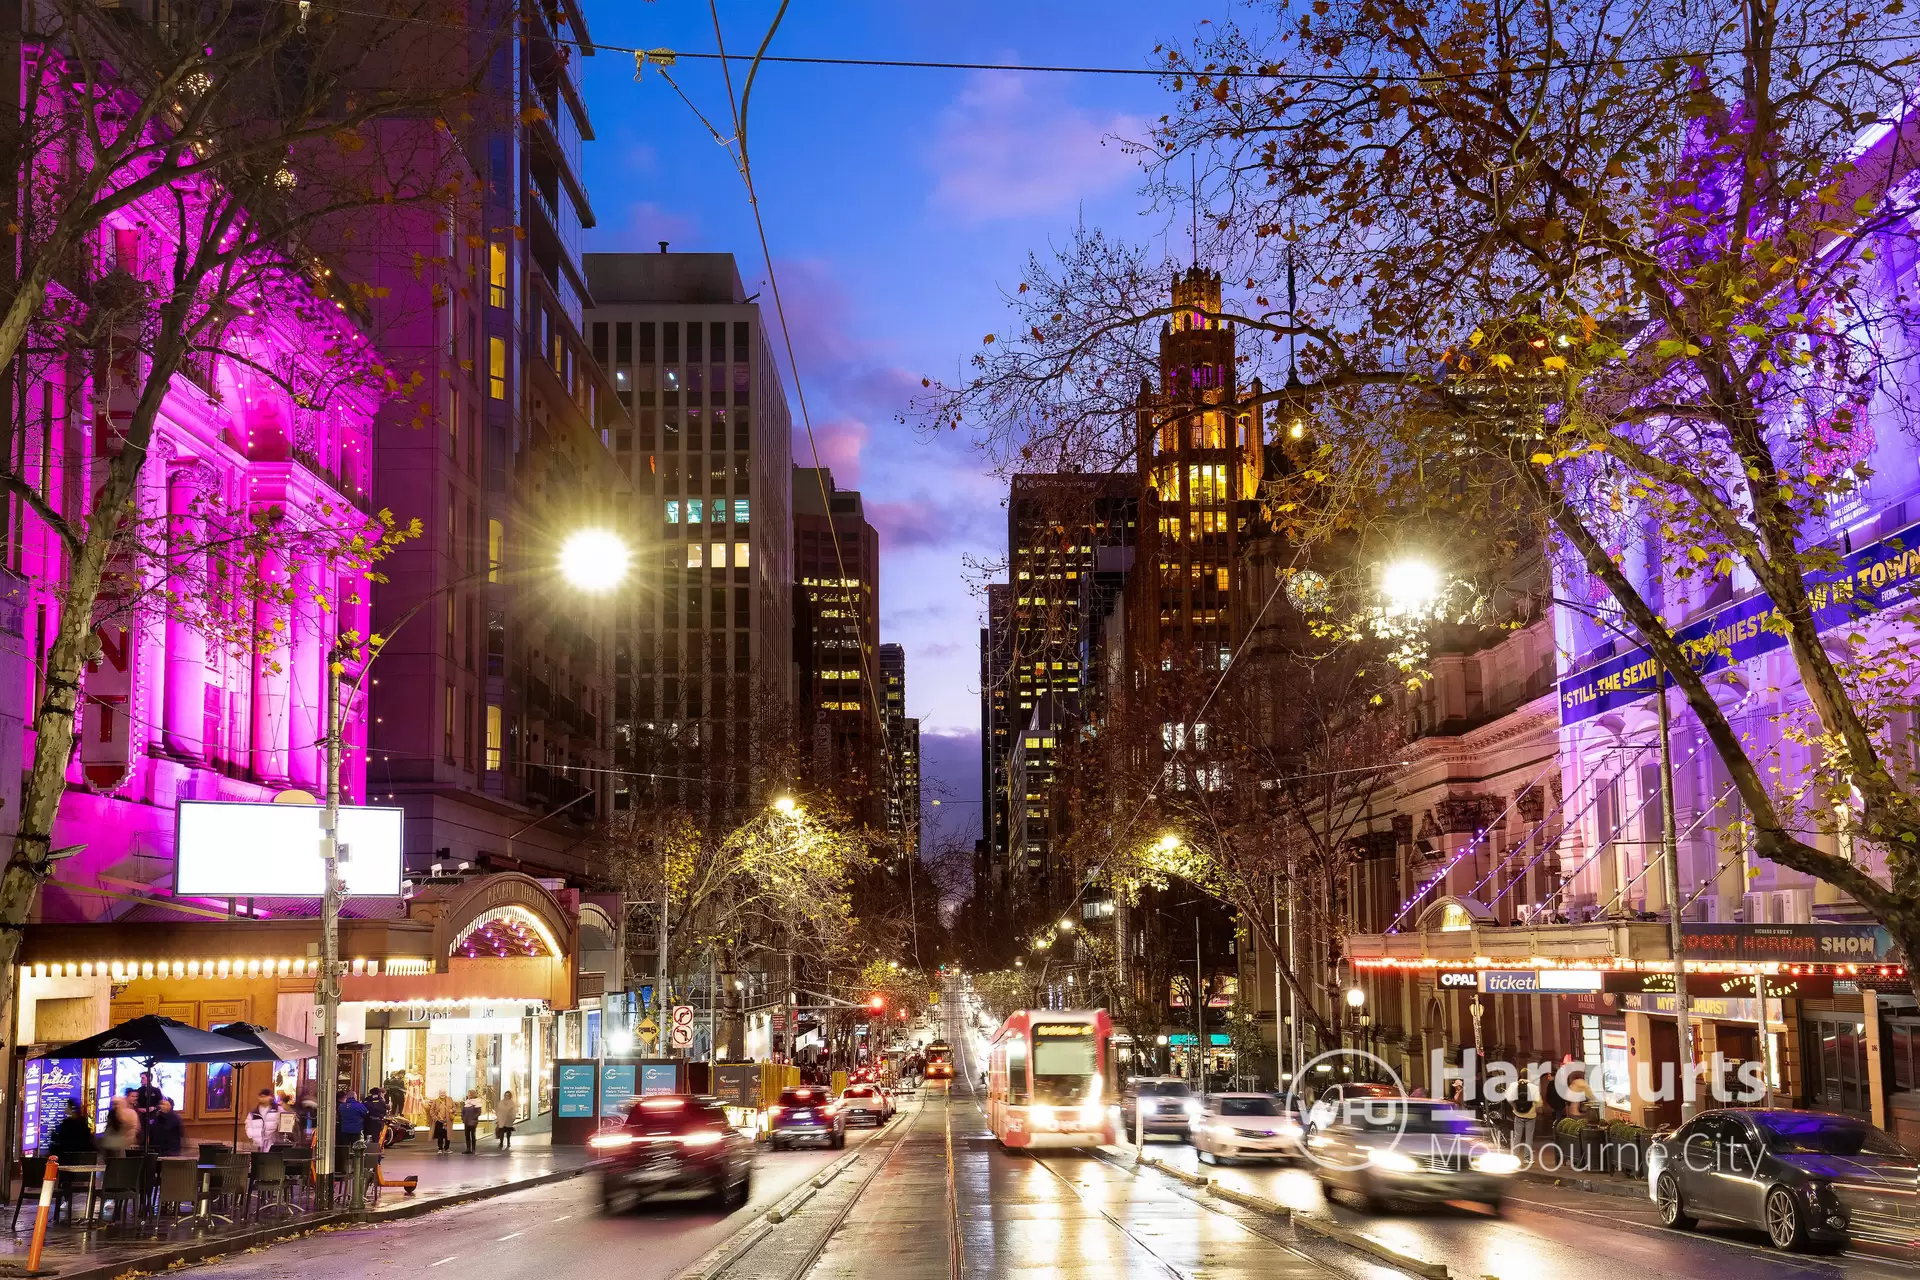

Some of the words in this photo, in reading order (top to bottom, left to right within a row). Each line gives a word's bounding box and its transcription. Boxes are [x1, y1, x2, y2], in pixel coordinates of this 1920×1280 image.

[1597, 671, 1622, 698] THE
[1832, 576, 1854, 604] IN
[1743, 935, 1817, 952] HORROR
[1821, 936, 1876, 956] SHOW
[1441, 973, 1477, 986] OPAL
[1721, 975, 1774, 993] BISTRT
[41, 1073, 78, 1088] Juliet
